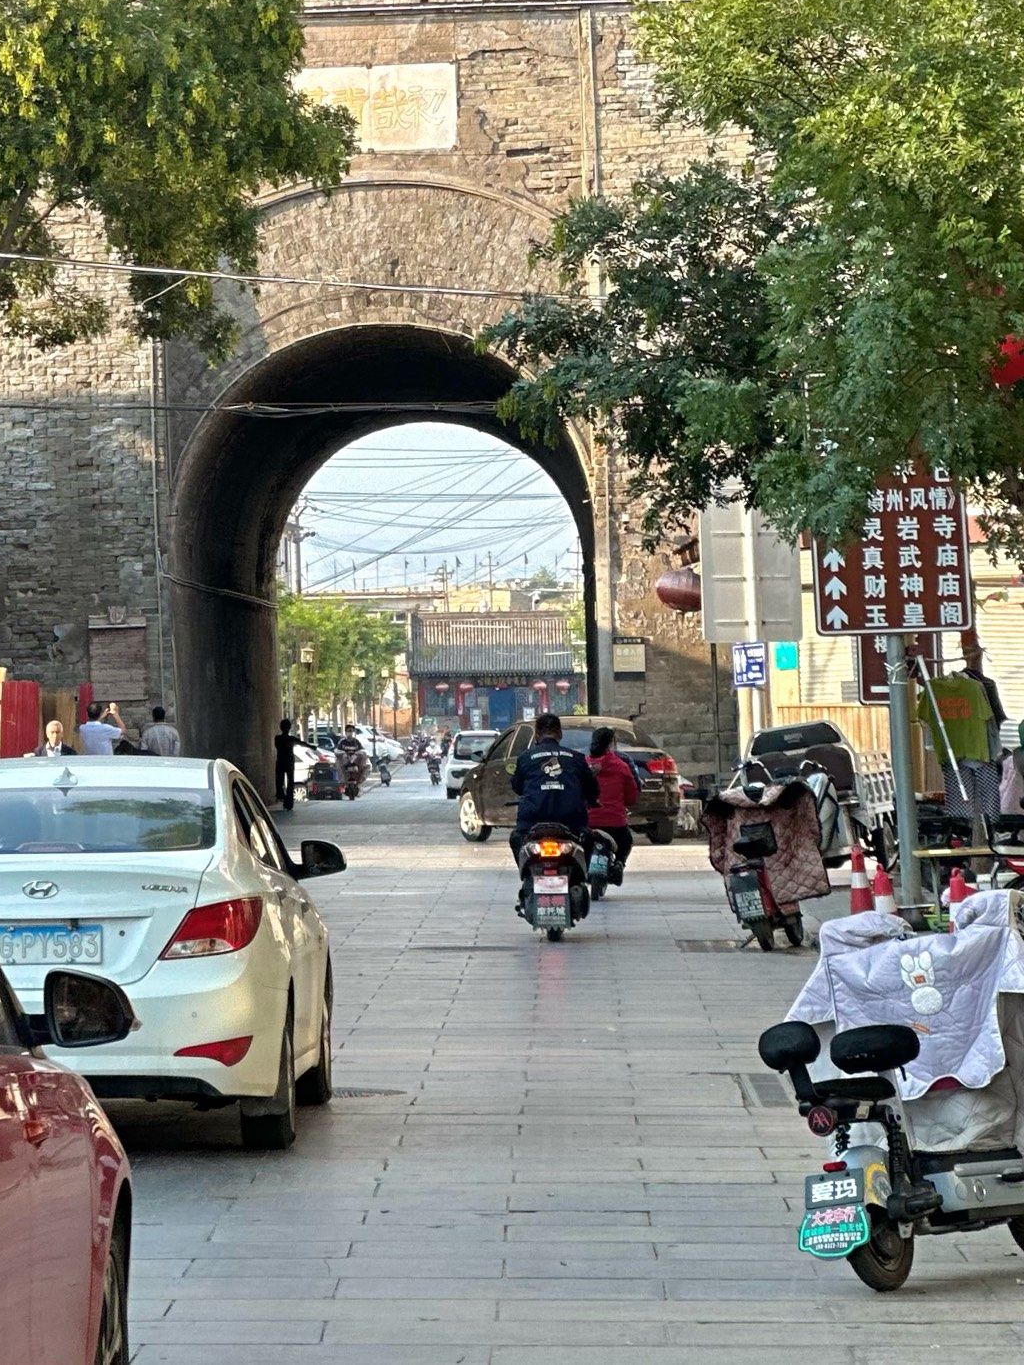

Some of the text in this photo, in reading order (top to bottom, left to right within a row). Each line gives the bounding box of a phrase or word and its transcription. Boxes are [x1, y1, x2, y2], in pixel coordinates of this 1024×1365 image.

[861, 514, 957, 542] 灵岩寺
[862, 543, 959, 570] 真武庙
[864, 572, 961, 599] 财神庙
[865, 601, 963, 627] 玉皇阁
[811, 1178, 858, 1203] 爱玛
